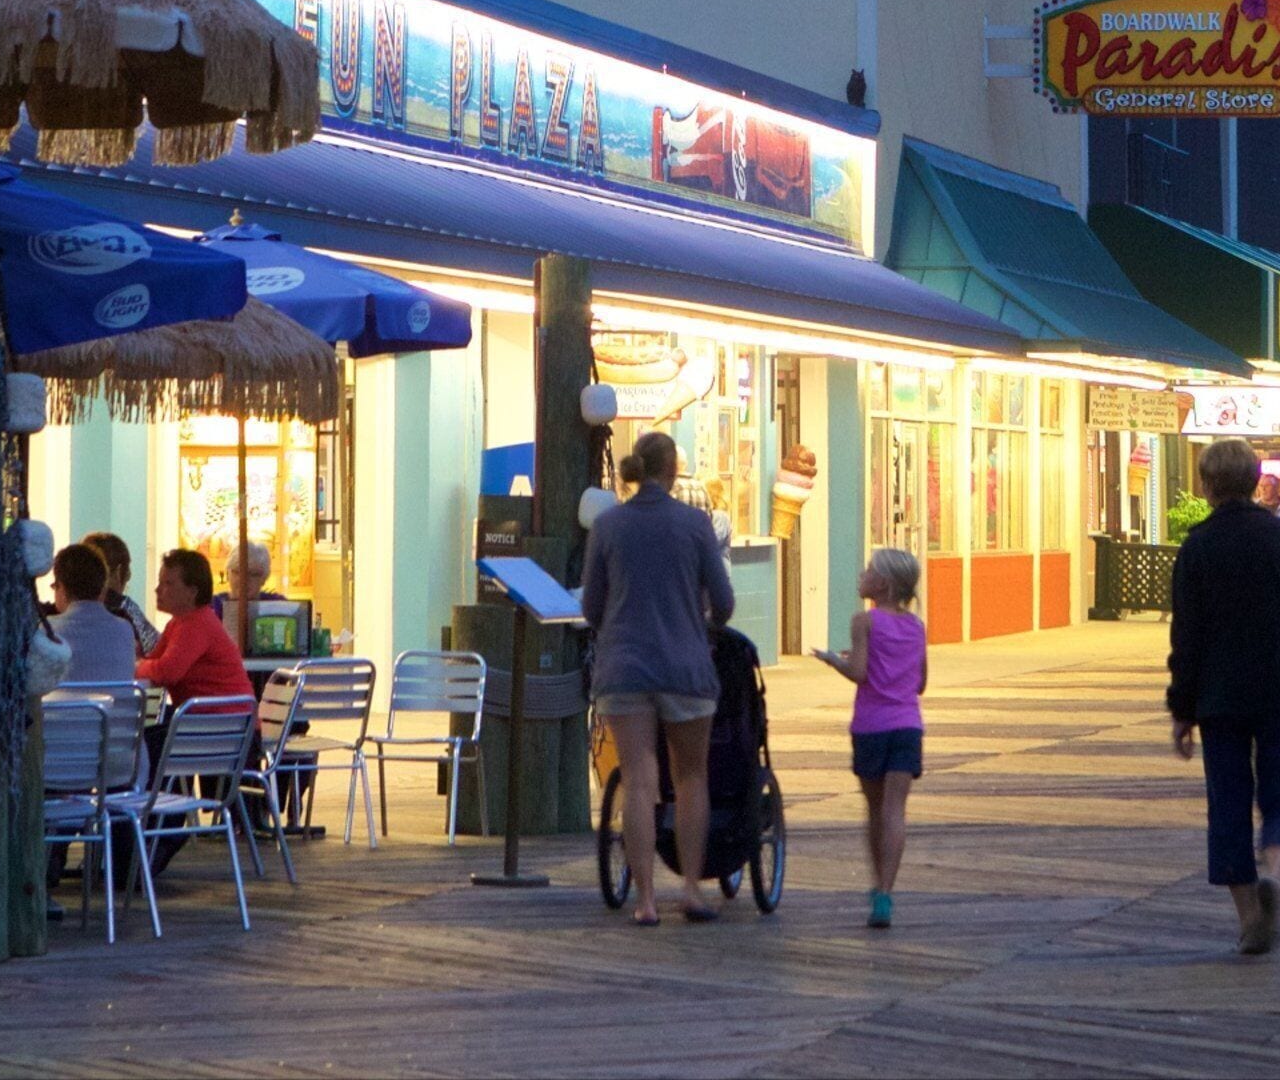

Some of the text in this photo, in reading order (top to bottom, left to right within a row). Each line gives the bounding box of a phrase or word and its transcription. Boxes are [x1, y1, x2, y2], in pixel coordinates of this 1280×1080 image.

[1101, 12, 1221, 32] BOARDWALK
[450, 20, 605, 175] PLAZA
[1095, 89, 1275, 111] General Store
[112, 293, 144, 306] BUD
[104, 302, 148, 317] LIGHT
[485, 532, 515, 544] NOTICE
